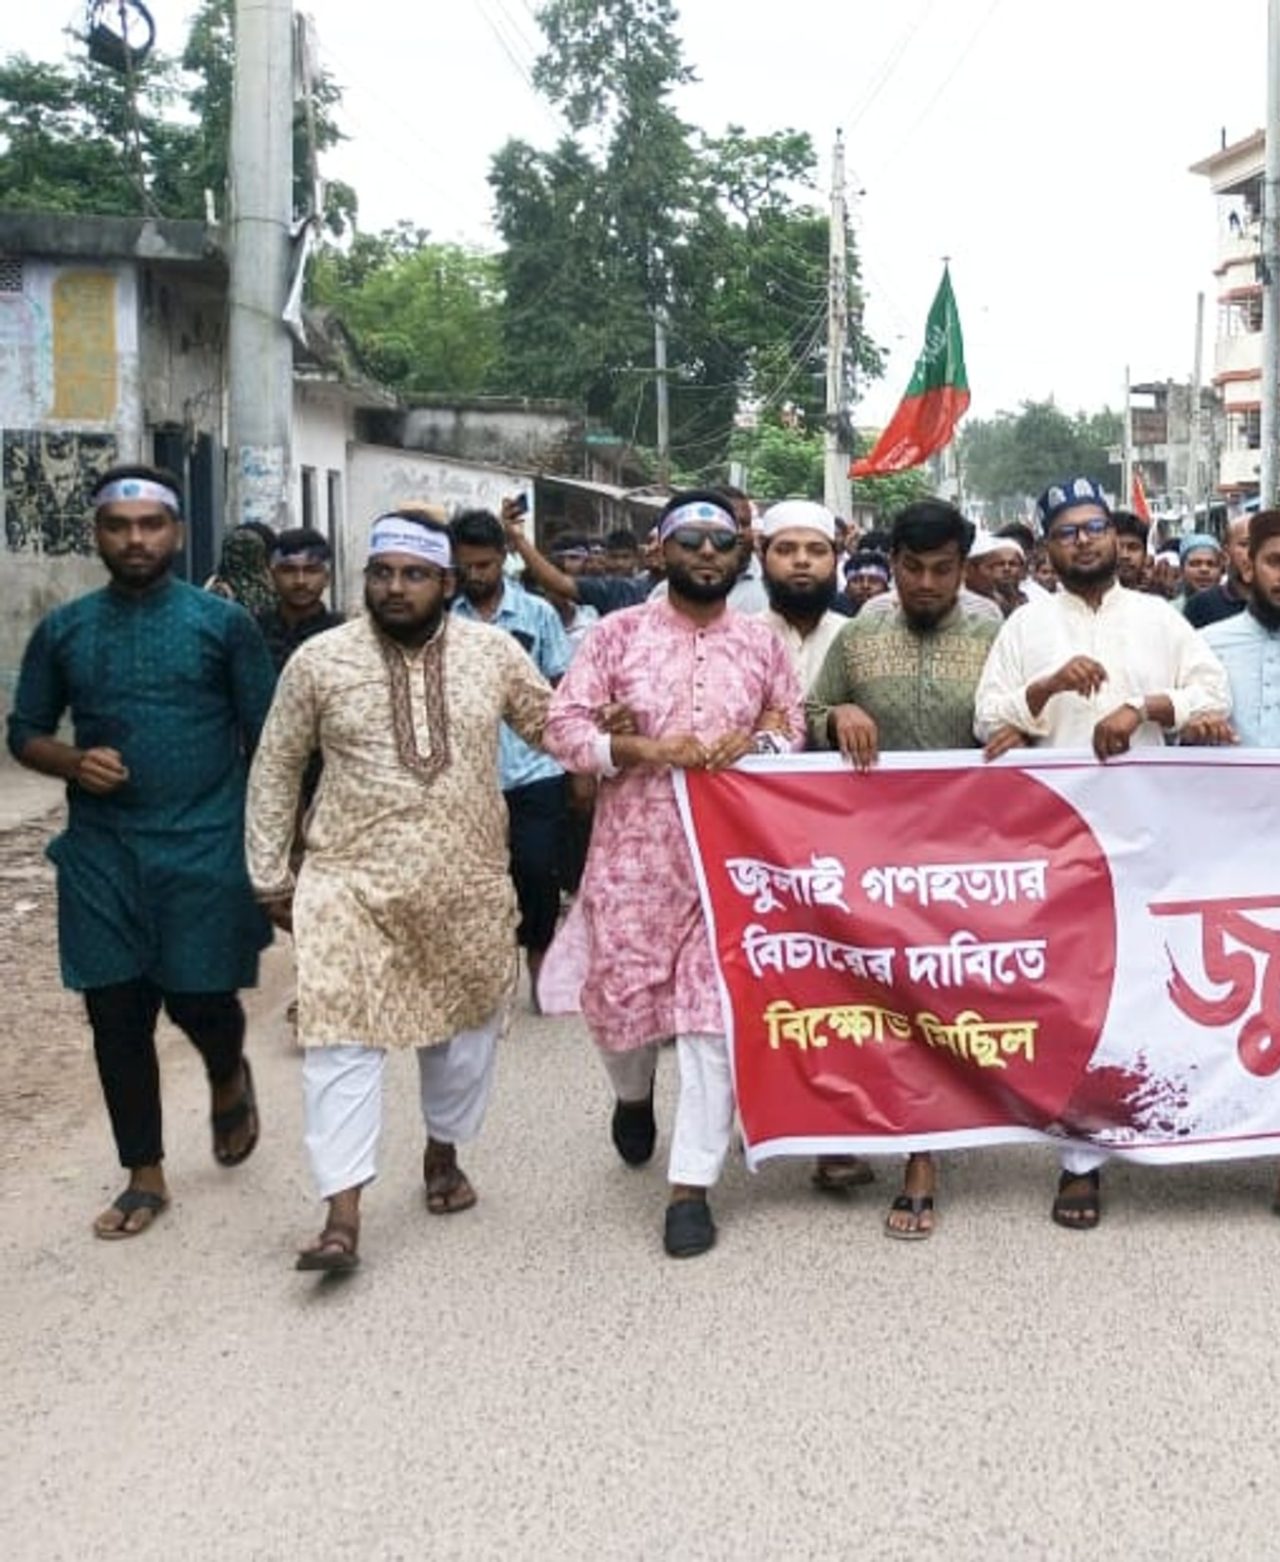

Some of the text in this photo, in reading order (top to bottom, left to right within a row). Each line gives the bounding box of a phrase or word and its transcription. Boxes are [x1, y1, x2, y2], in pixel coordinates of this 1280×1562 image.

[726, 853, 1048, 913] জুলাই গণহত্যার
[742, 924, 1047, 988] বিচারের দাবিতে
[764, 1000, 913, 1050] বিক্ষোভ
